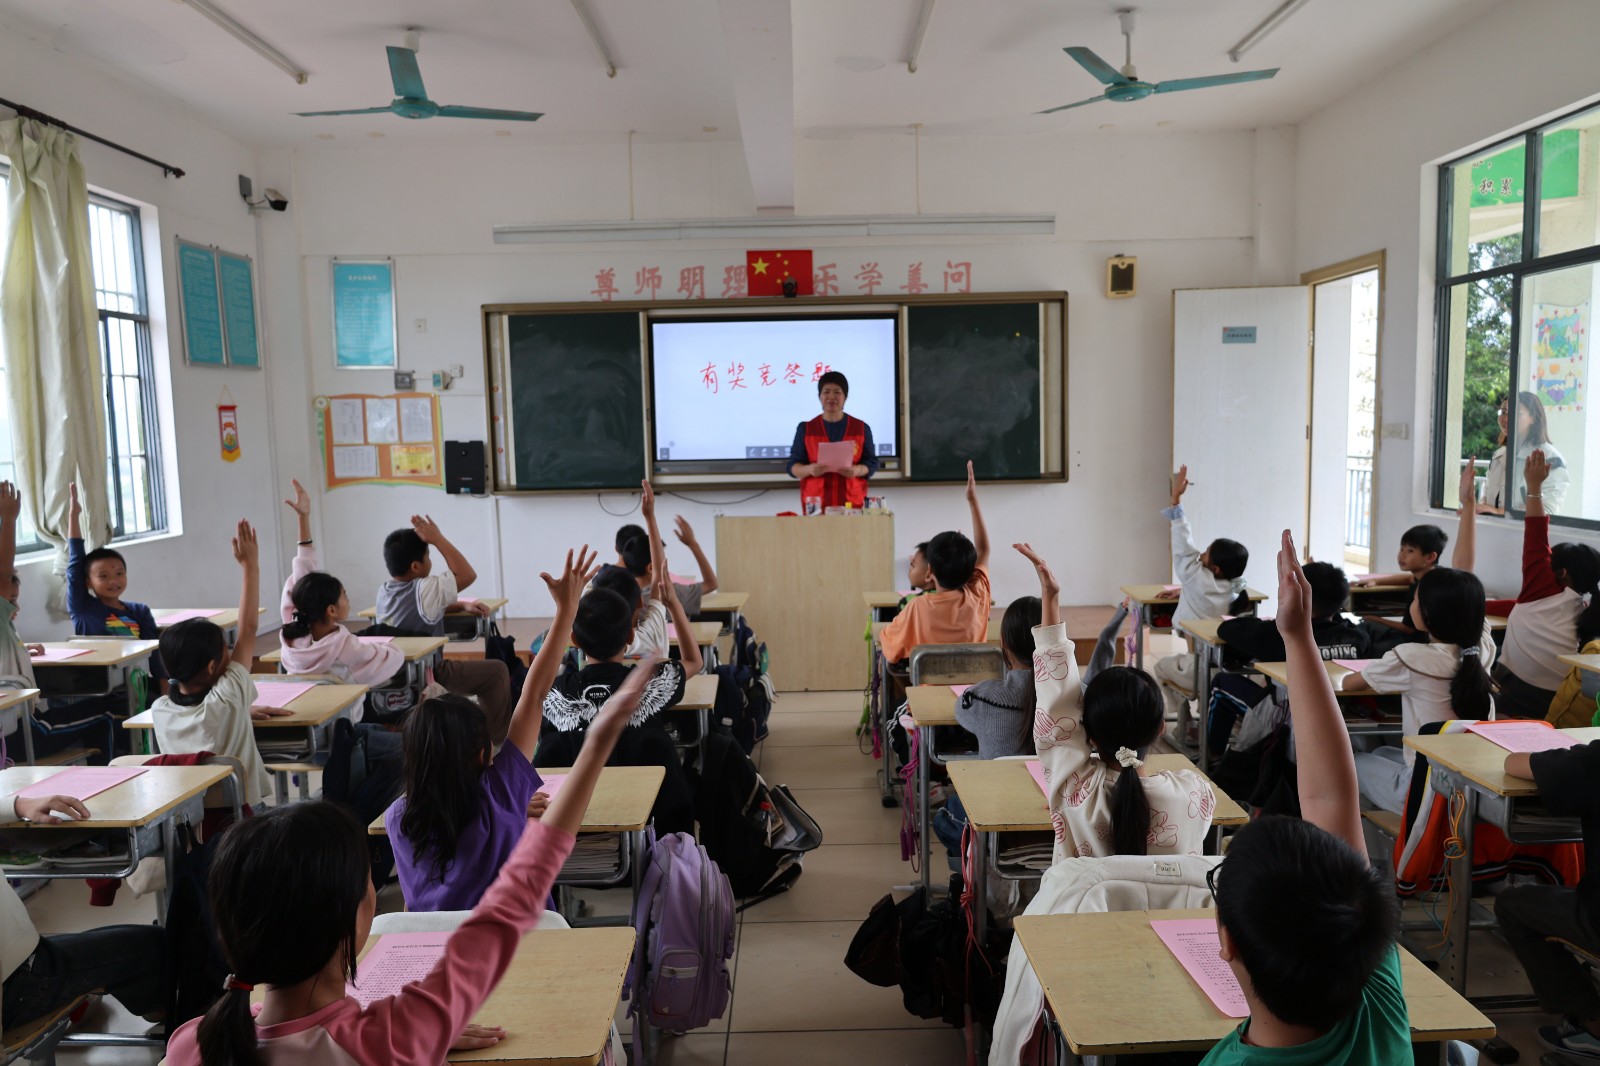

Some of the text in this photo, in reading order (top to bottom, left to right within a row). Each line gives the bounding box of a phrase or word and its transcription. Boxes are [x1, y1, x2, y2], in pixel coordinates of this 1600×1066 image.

[591, 261, 972, 302] 尊师明理 乐学善问
